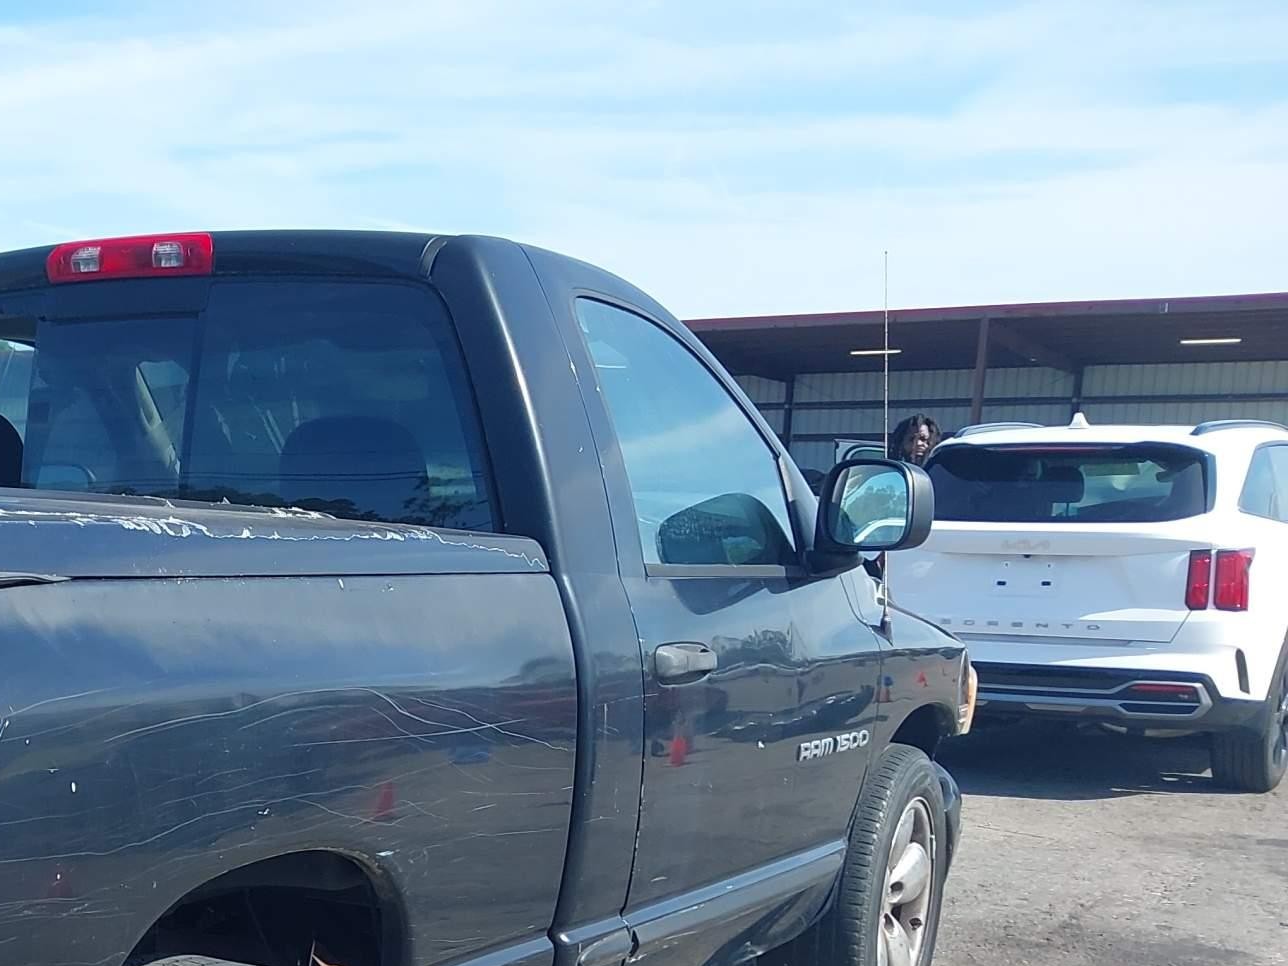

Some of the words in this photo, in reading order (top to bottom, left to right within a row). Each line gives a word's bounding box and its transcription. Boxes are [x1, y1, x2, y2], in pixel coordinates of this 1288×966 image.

[940, 617, 1101, 631] SORENTO
[799, 737, 834, 762] RAM
[835, 729, 870, 753] 1500
